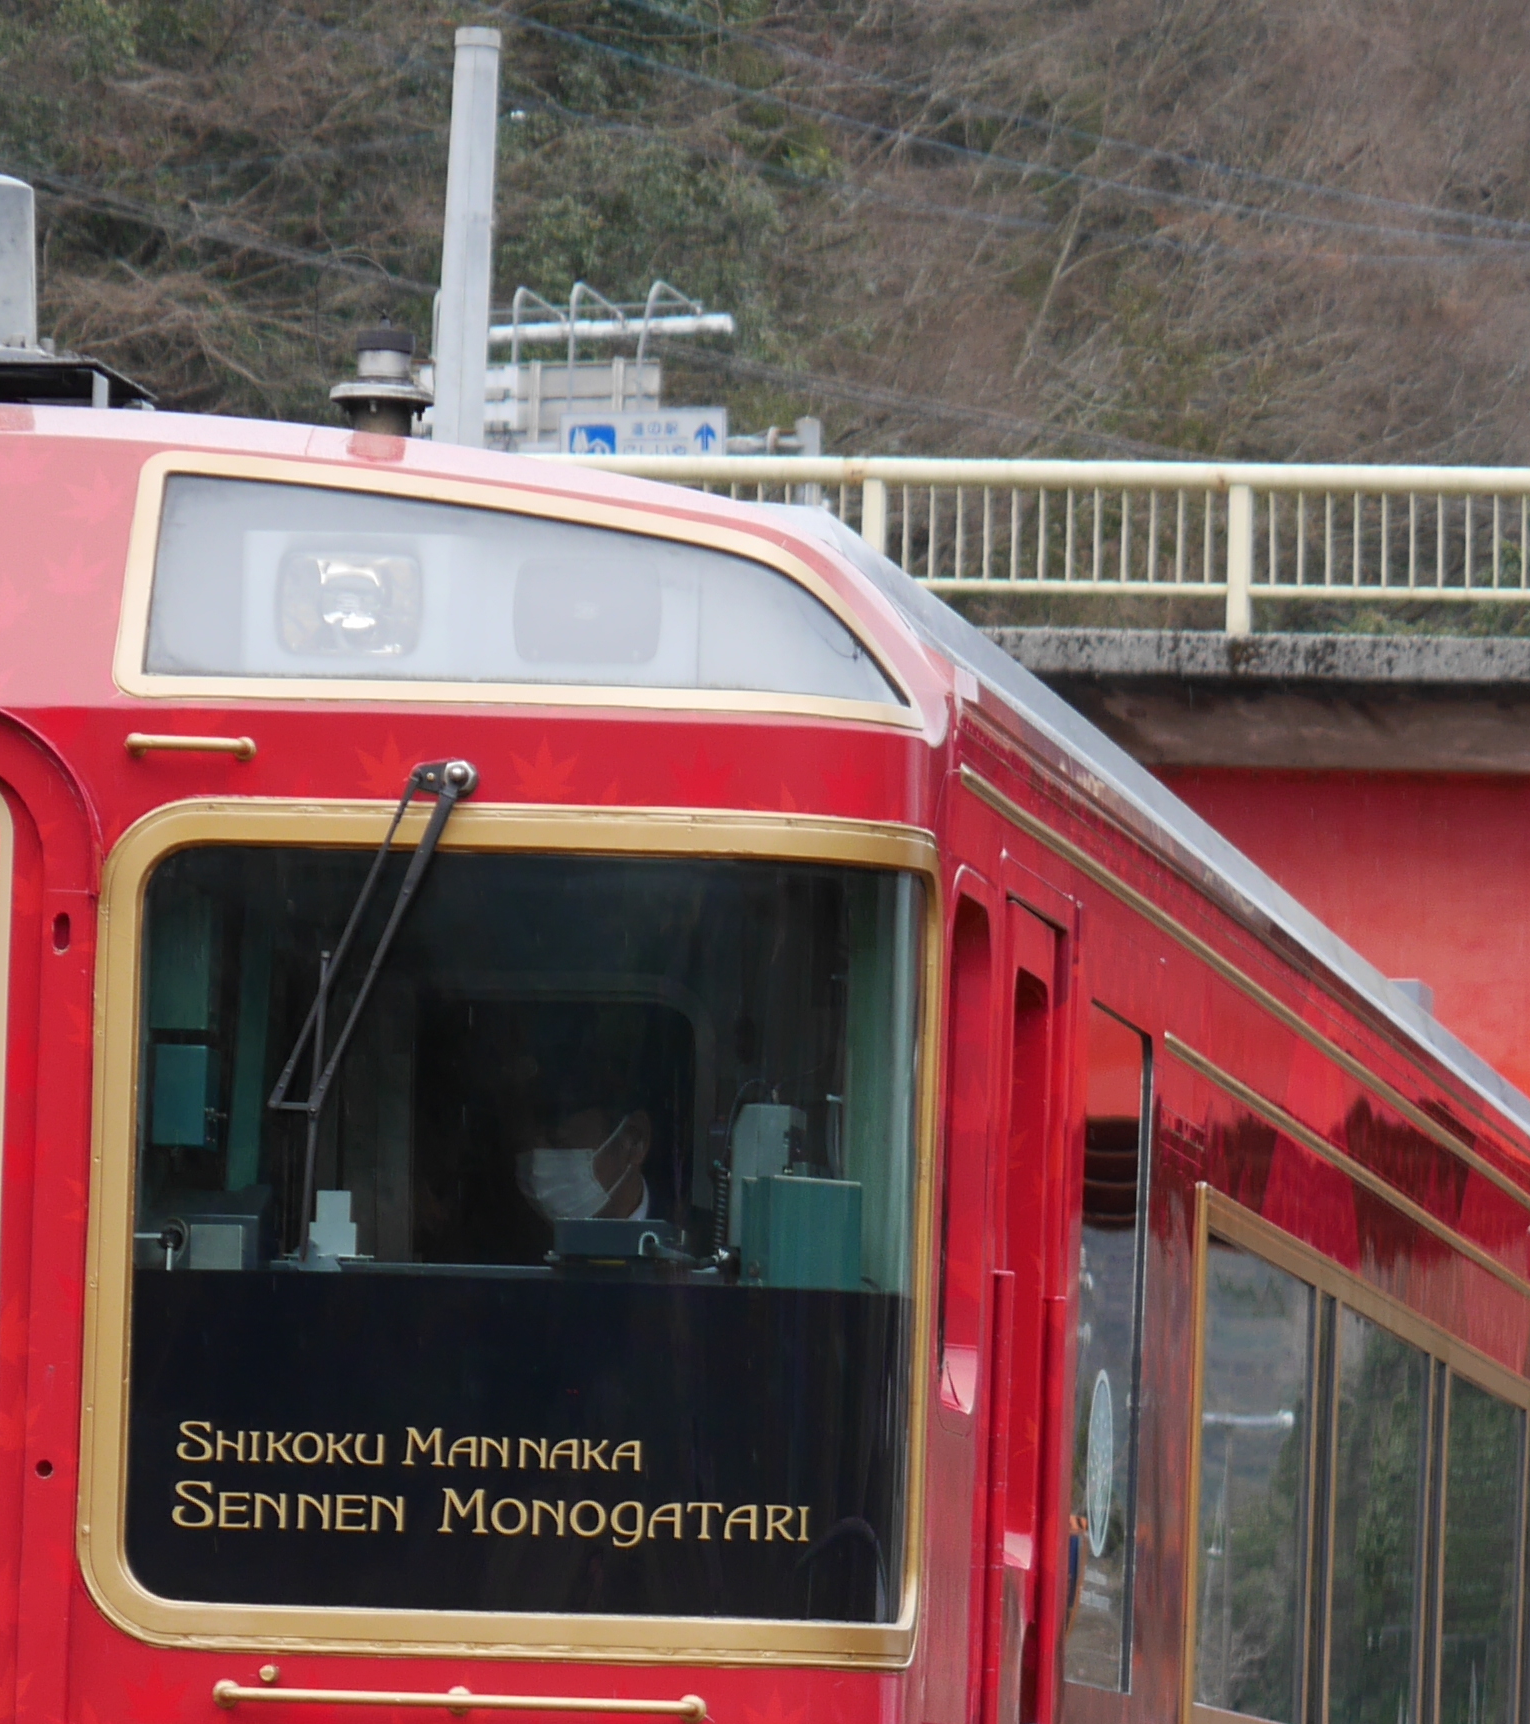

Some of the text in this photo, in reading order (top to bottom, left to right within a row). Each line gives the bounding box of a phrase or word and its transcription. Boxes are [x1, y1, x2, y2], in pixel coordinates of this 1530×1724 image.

[175, 1420, 642, 1472] SHIKOKU MANNAKA
[171, 1480, 405, 1531] SENNEN
